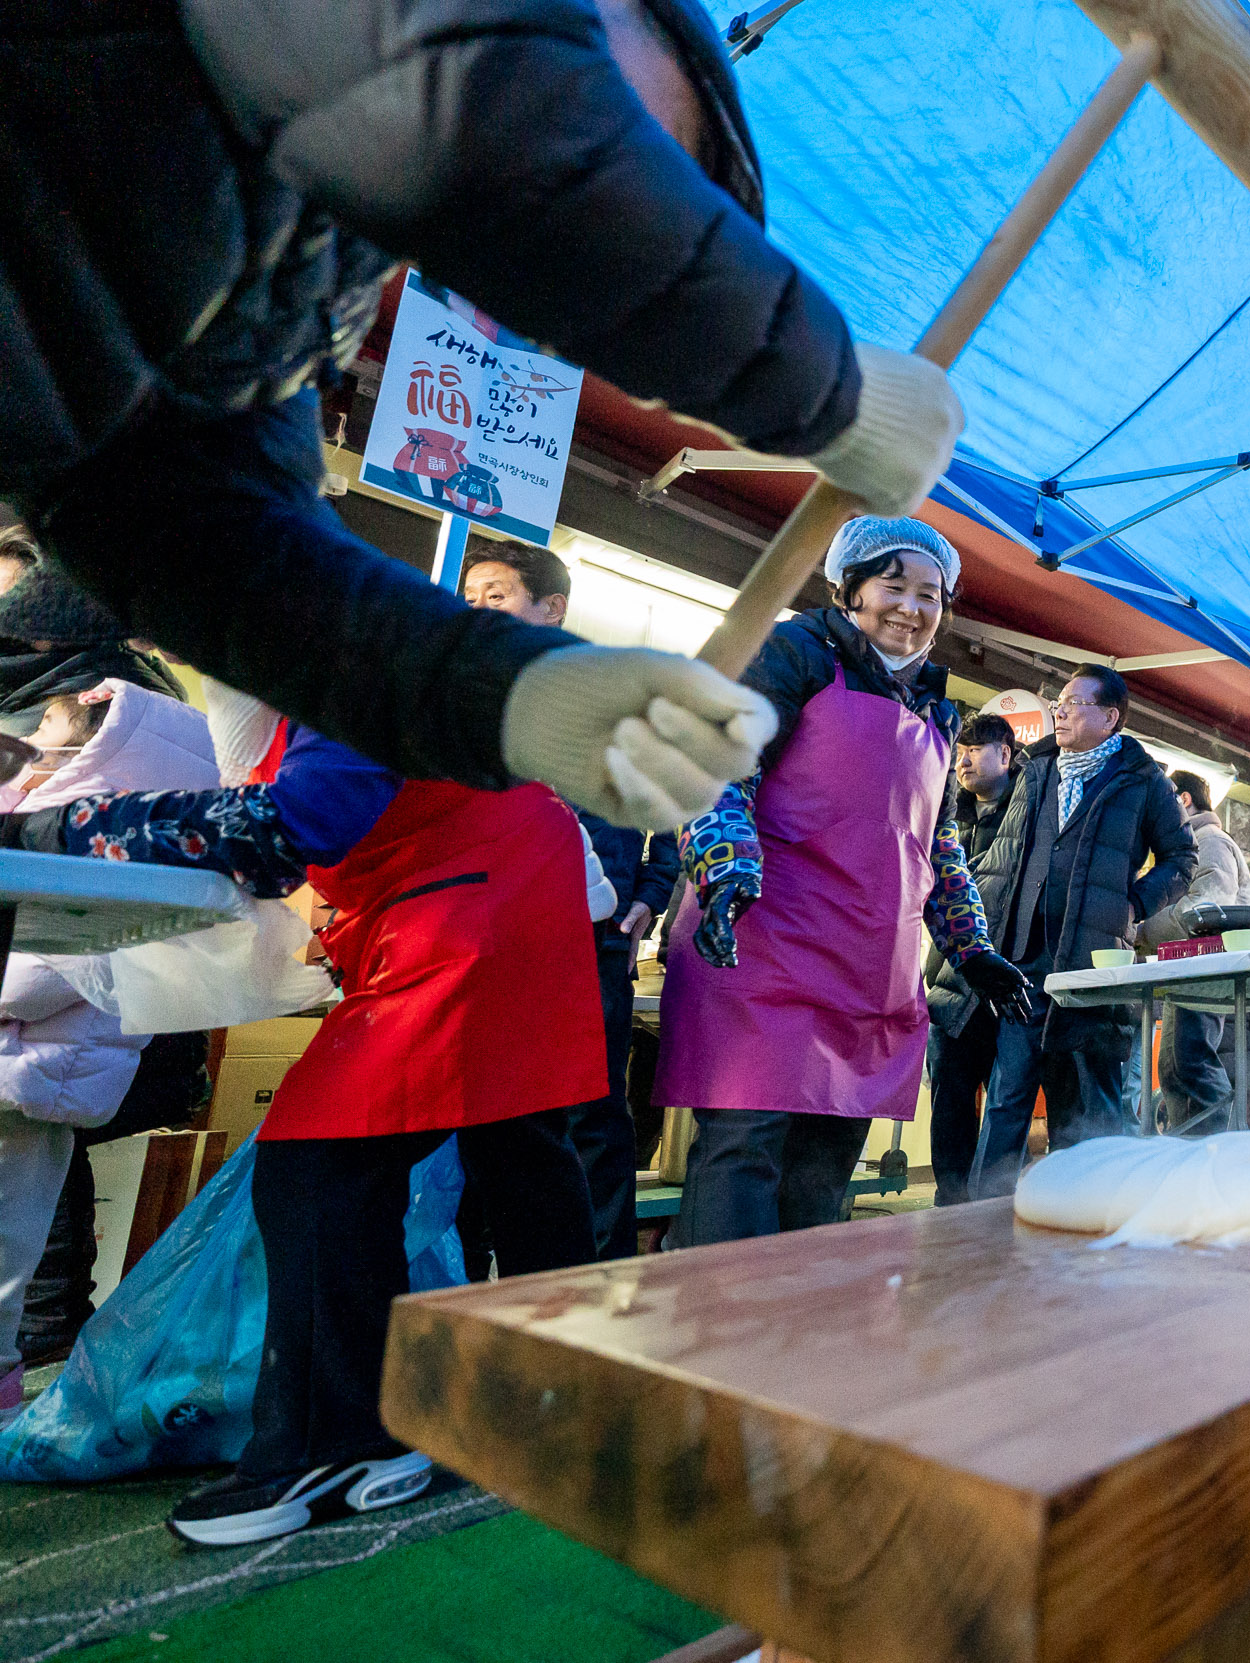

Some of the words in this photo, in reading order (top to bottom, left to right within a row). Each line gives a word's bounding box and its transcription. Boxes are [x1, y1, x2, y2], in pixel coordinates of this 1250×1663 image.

[426, 329, 498, 369] 새해
[407, 360, 472, 428] 福
[488, 387, 538, 418] 많이
[476, 414, 559, 461] 받으세요
[478, 452, 549, 489] 면곡시장상인회
